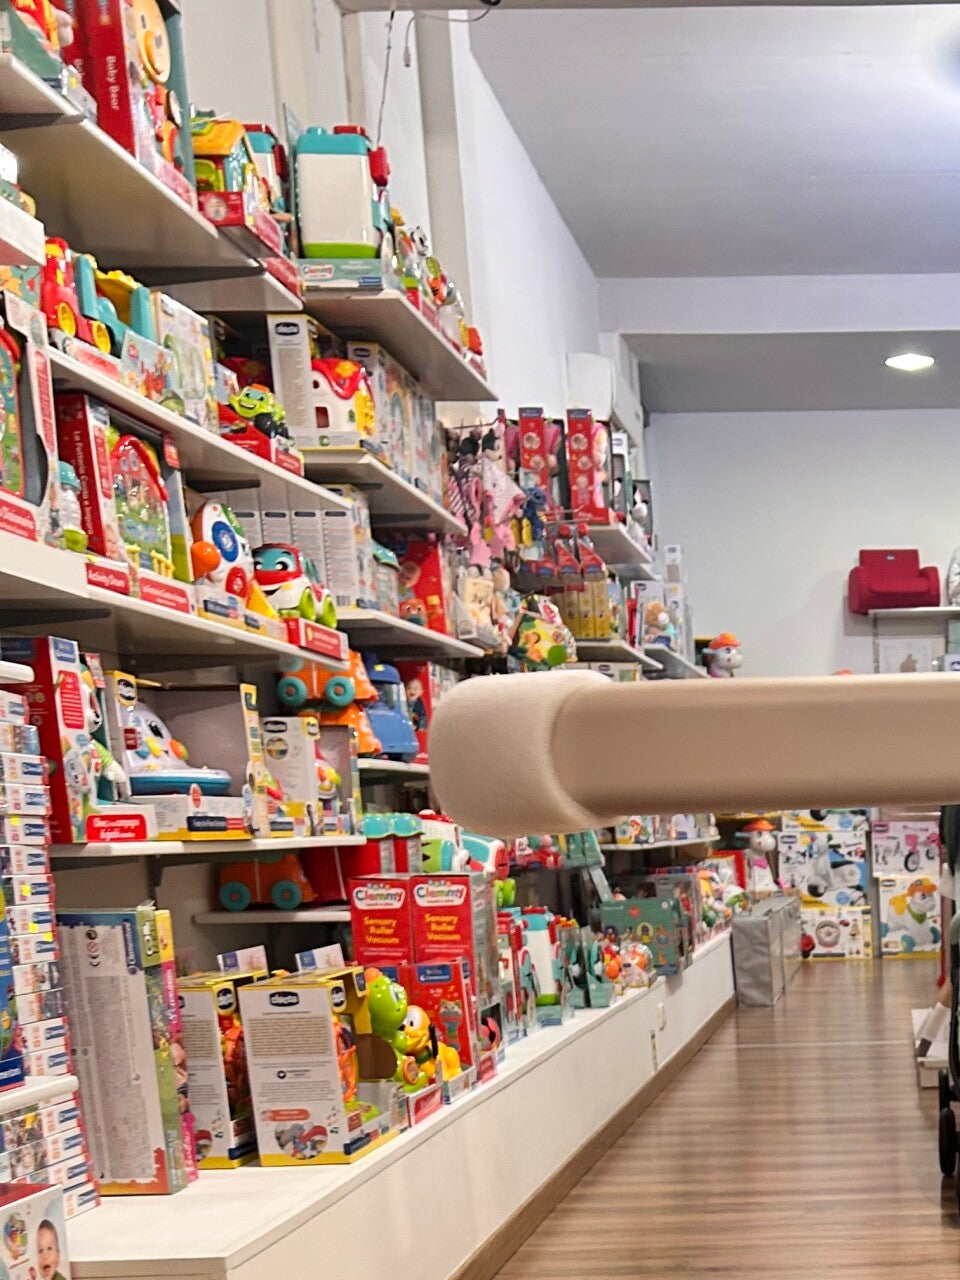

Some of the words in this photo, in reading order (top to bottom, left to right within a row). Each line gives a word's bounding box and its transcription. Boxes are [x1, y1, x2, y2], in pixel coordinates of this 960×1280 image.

[416, 885, 465, 900] Clemmy
[363, 916, 398, 928] Sensory
[424, 913, 459, 925] Sensory
